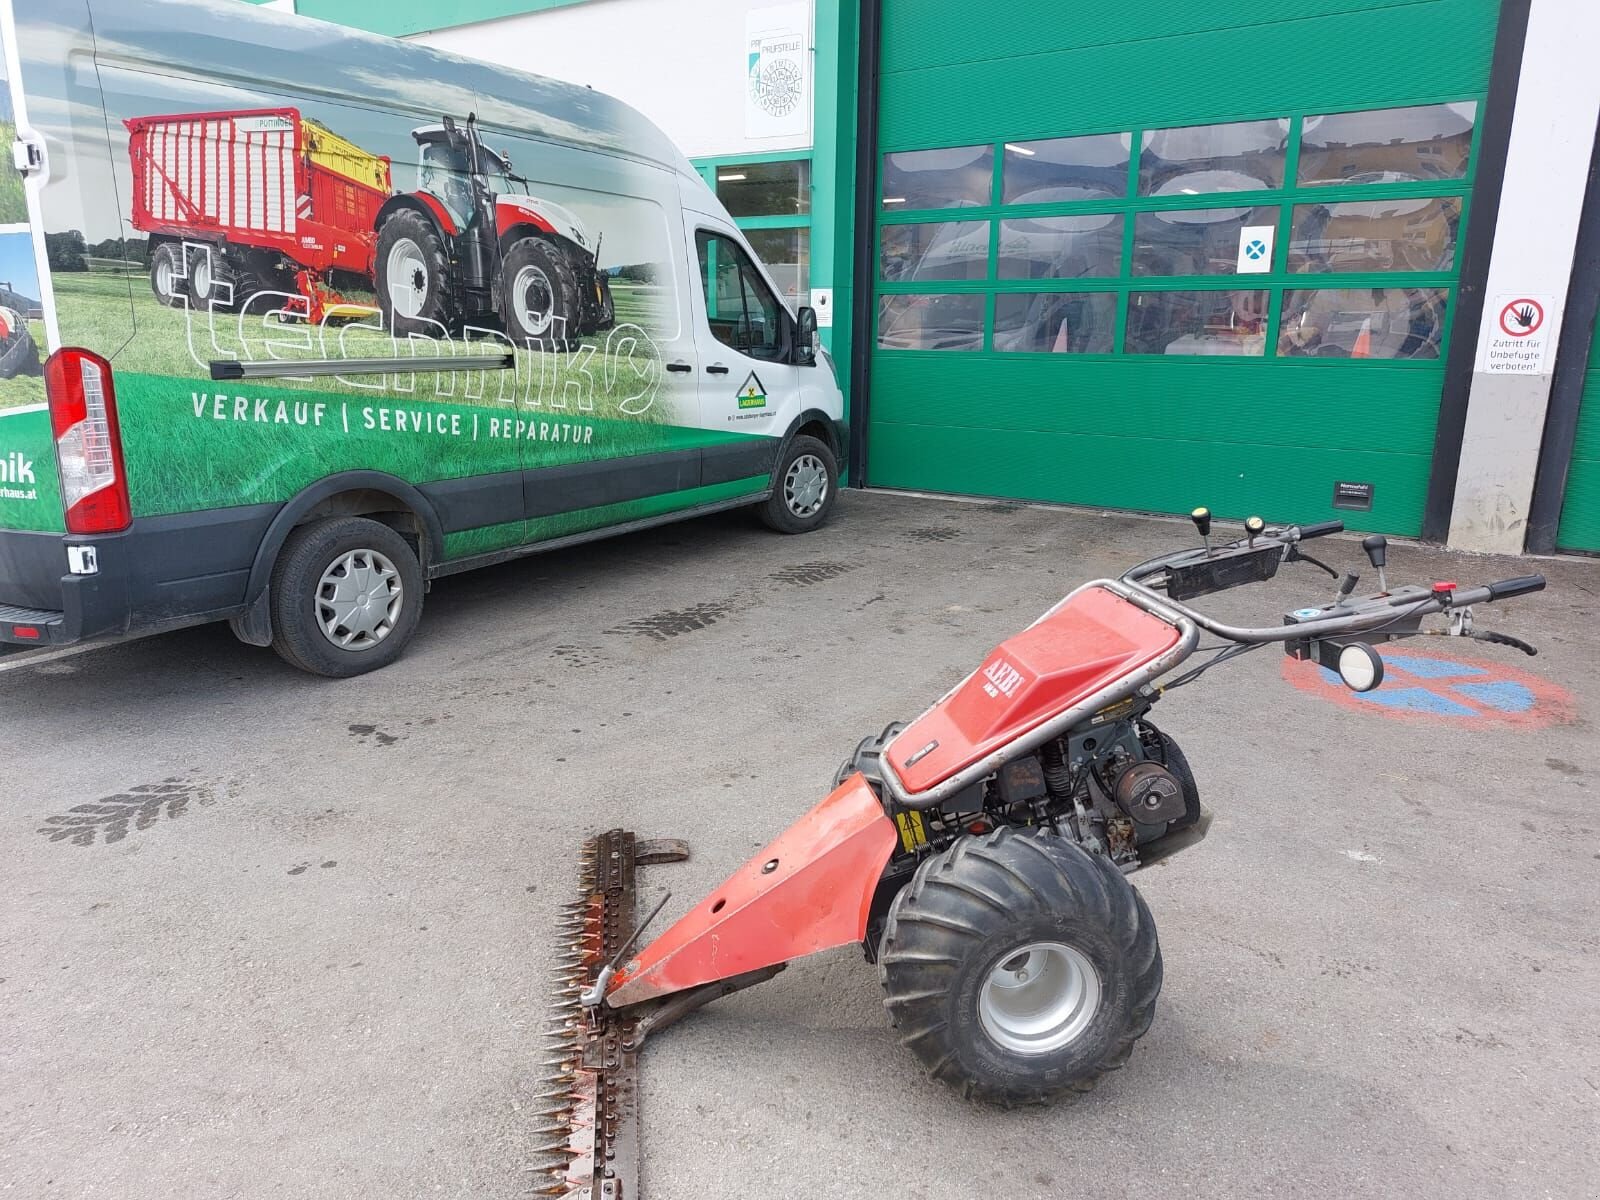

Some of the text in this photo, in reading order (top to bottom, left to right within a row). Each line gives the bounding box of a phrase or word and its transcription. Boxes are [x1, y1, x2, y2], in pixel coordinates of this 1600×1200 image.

[1492, 339, 1542, 348] Zutritt für
[1490, 350, 1540, 361] Unbefugte
[1490, 362, 1536, 371] verboten!
[191, 392, 594, 445] VERKAUF SERVICE REPARATUR
[0, 486, 38, 500] rhaus.at
[982, 657, 1025, 699] AEBI
